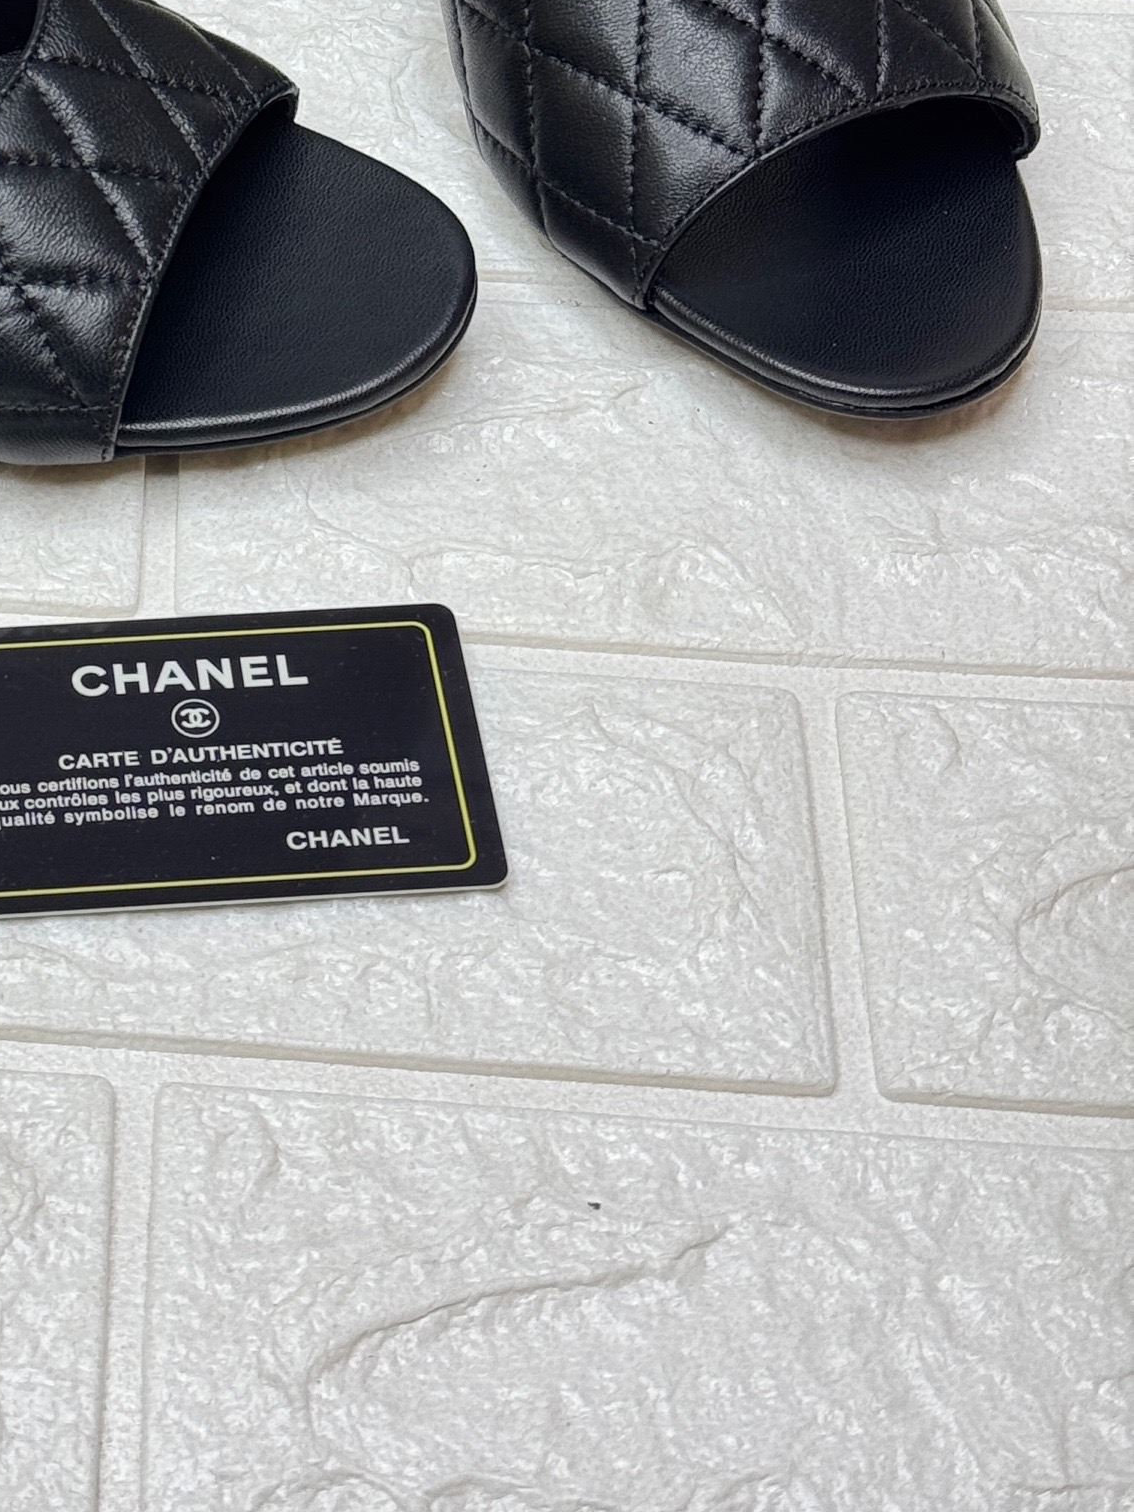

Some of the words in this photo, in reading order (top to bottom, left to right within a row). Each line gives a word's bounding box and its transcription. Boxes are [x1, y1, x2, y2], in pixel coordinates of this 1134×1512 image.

[71, 654, 309, 697] CHANEL
[58, 750, 141, 771] CARTE
[150, 737, 344, 766] D'AUTHENTICITÉ
[24, 792, 109, 810] contrôles
[115, 790, 142, 804] les
[147, 788, 186, 805] plus
[190, 783, 280, 804] rigoureux,
[284, 781, 303, 794] et
[307, 778, 348, 793] dont
[352, 777, 370, 790] la
[373, 774, 423, 789] haute
[37, 775, 120, 794] certifions
[124, 767, 233, 789] l'authenticité
[239, 767, 262, 781] de
[268, 765, 296, 779] cet
[300, 761, 354, 778] article
[358, 758, 420, 776] soumis
[64, 806, 159, 827] symbolise
[169, 803, 186, 818] le
[195, 800, 255, 816] renom
[263, 796, 287, 812] de
[295, 793, 345, 810] notre
[353, 790, 430, 808] Marque.
[286, 825, 411, 851] CHANEL
